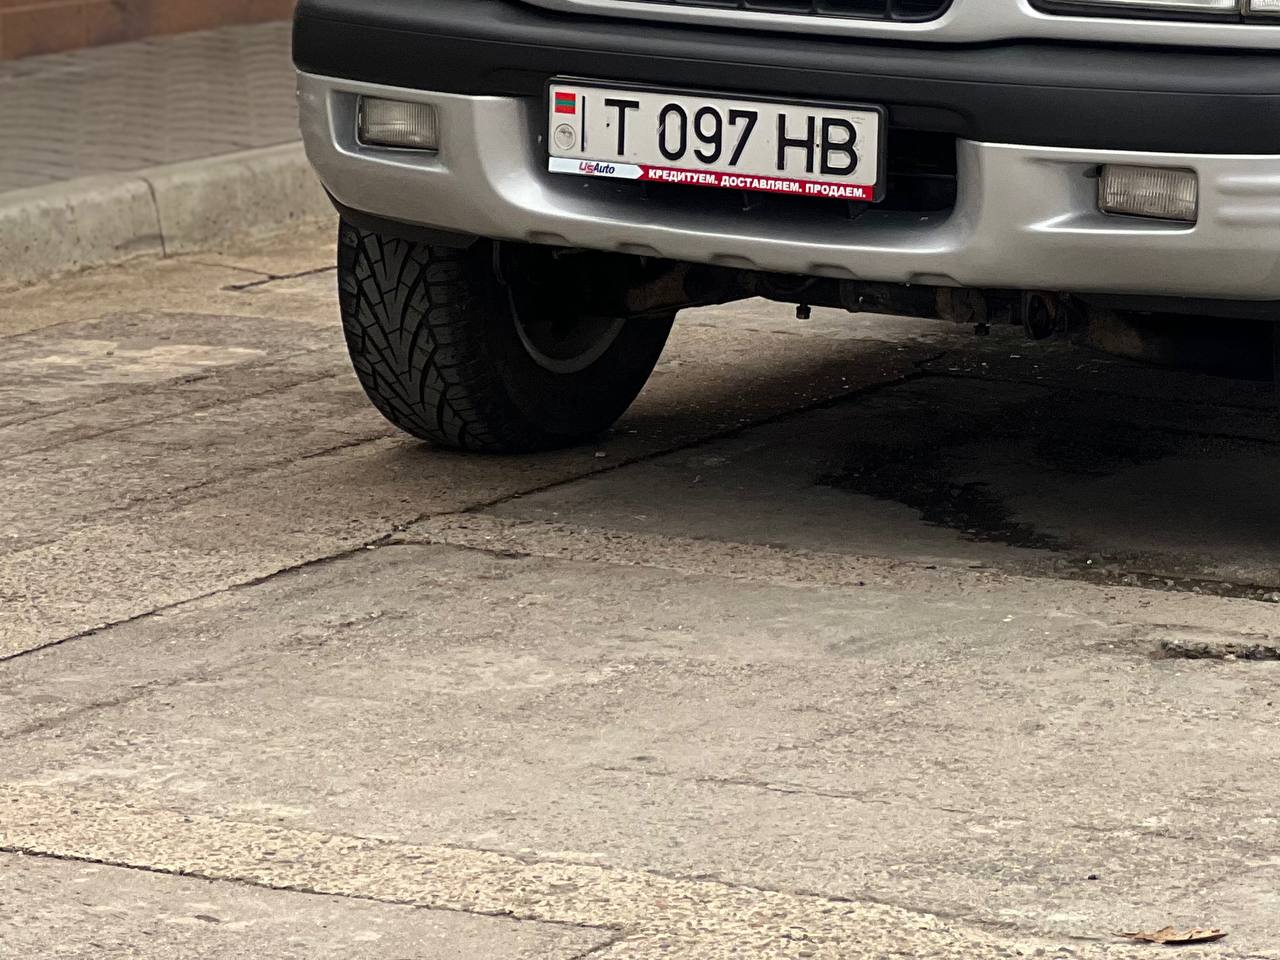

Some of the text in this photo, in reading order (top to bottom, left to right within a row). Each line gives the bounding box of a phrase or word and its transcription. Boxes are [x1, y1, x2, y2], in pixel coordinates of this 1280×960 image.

[604, 97, 859, 176] T 097 HB
[648, 168, 866, 199] КРЕДИТУЕМ. ДОСТАВЛЯЕМ. ПРОДАЕМ.
